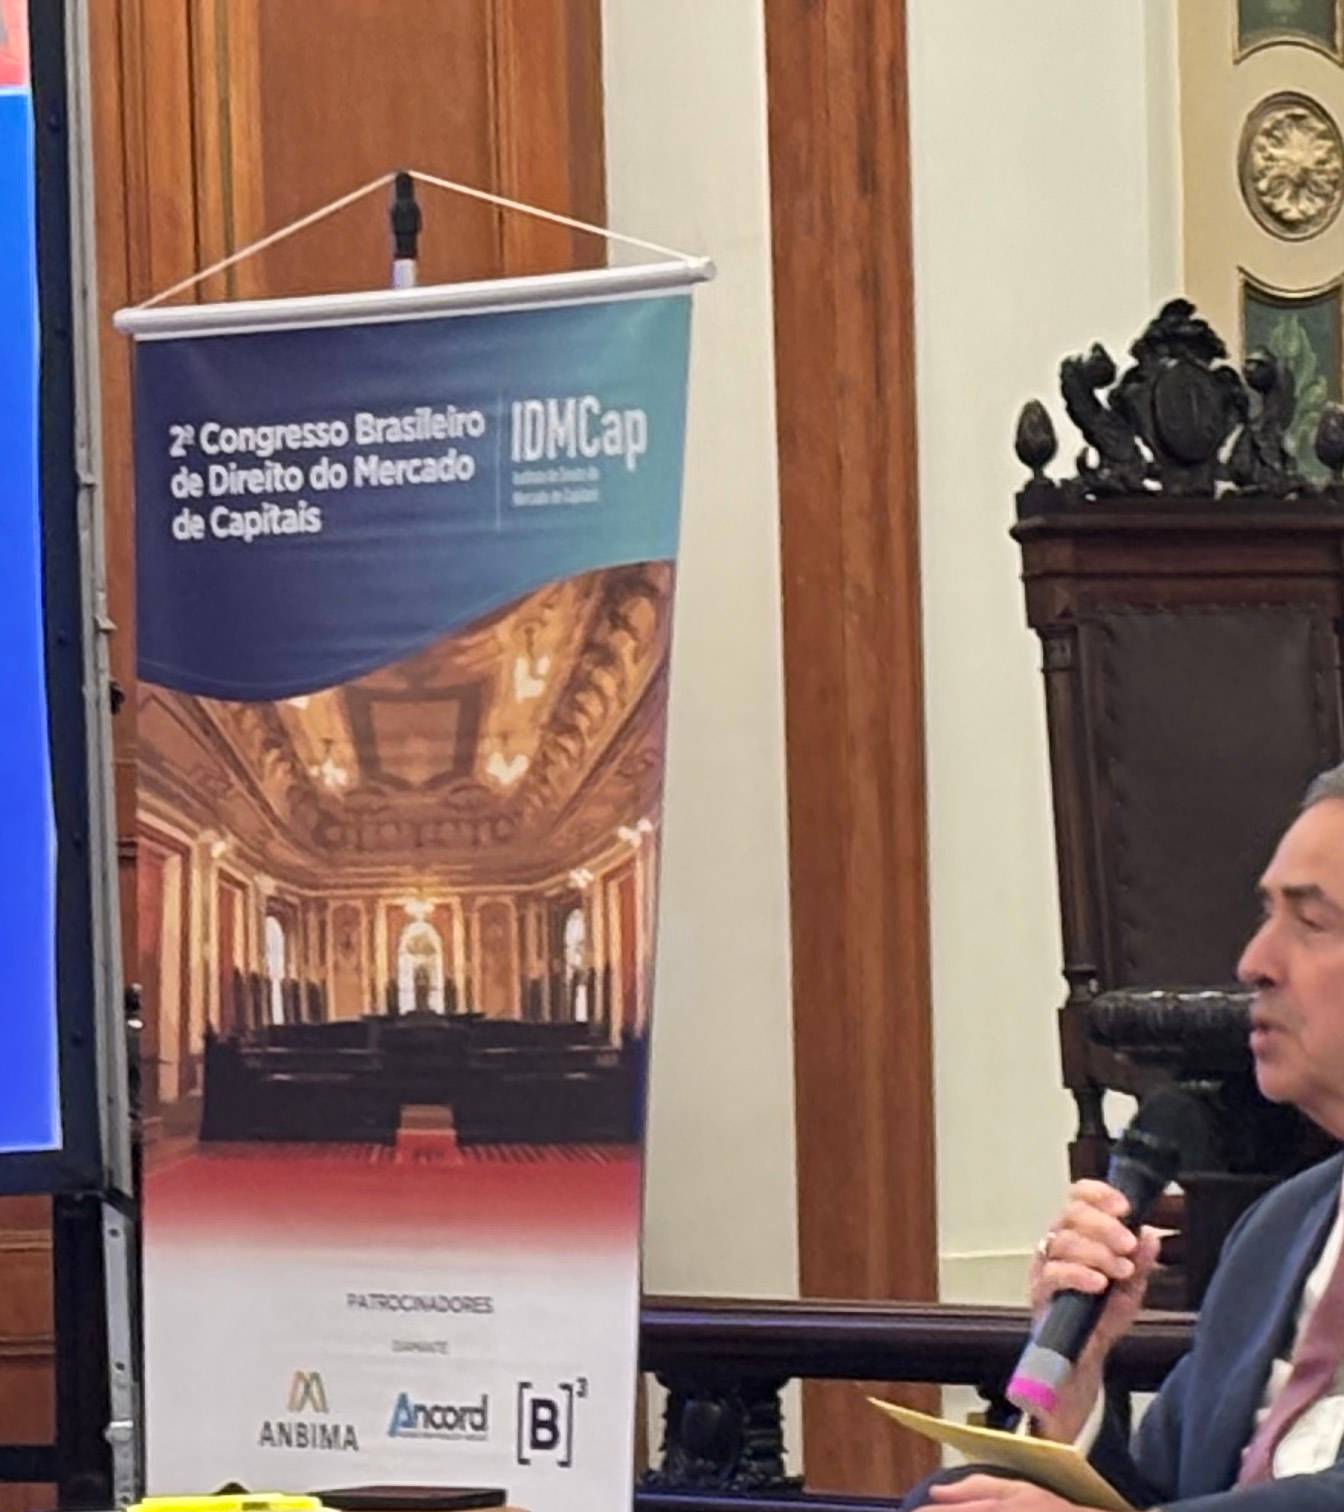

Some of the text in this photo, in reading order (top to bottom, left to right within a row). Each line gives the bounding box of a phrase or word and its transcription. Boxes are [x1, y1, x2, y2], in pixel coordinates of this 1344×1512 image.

[201, 418, 348, 458] Congresso
[355, 406, 485, 447] Brasileiro
[512, 395, 648, 472] IDMCap
[171, 466, 204, 498] de
[209, 461, 304, 496] Direito
[310, 458, 344, 491] do
[354, 449, 474, 489] Mercado
[172, 500, 322, 543] de Capitais
[260, 1422, 358, 1450] ANBIMA
[388, 1392, 488, 1436] Ancord
